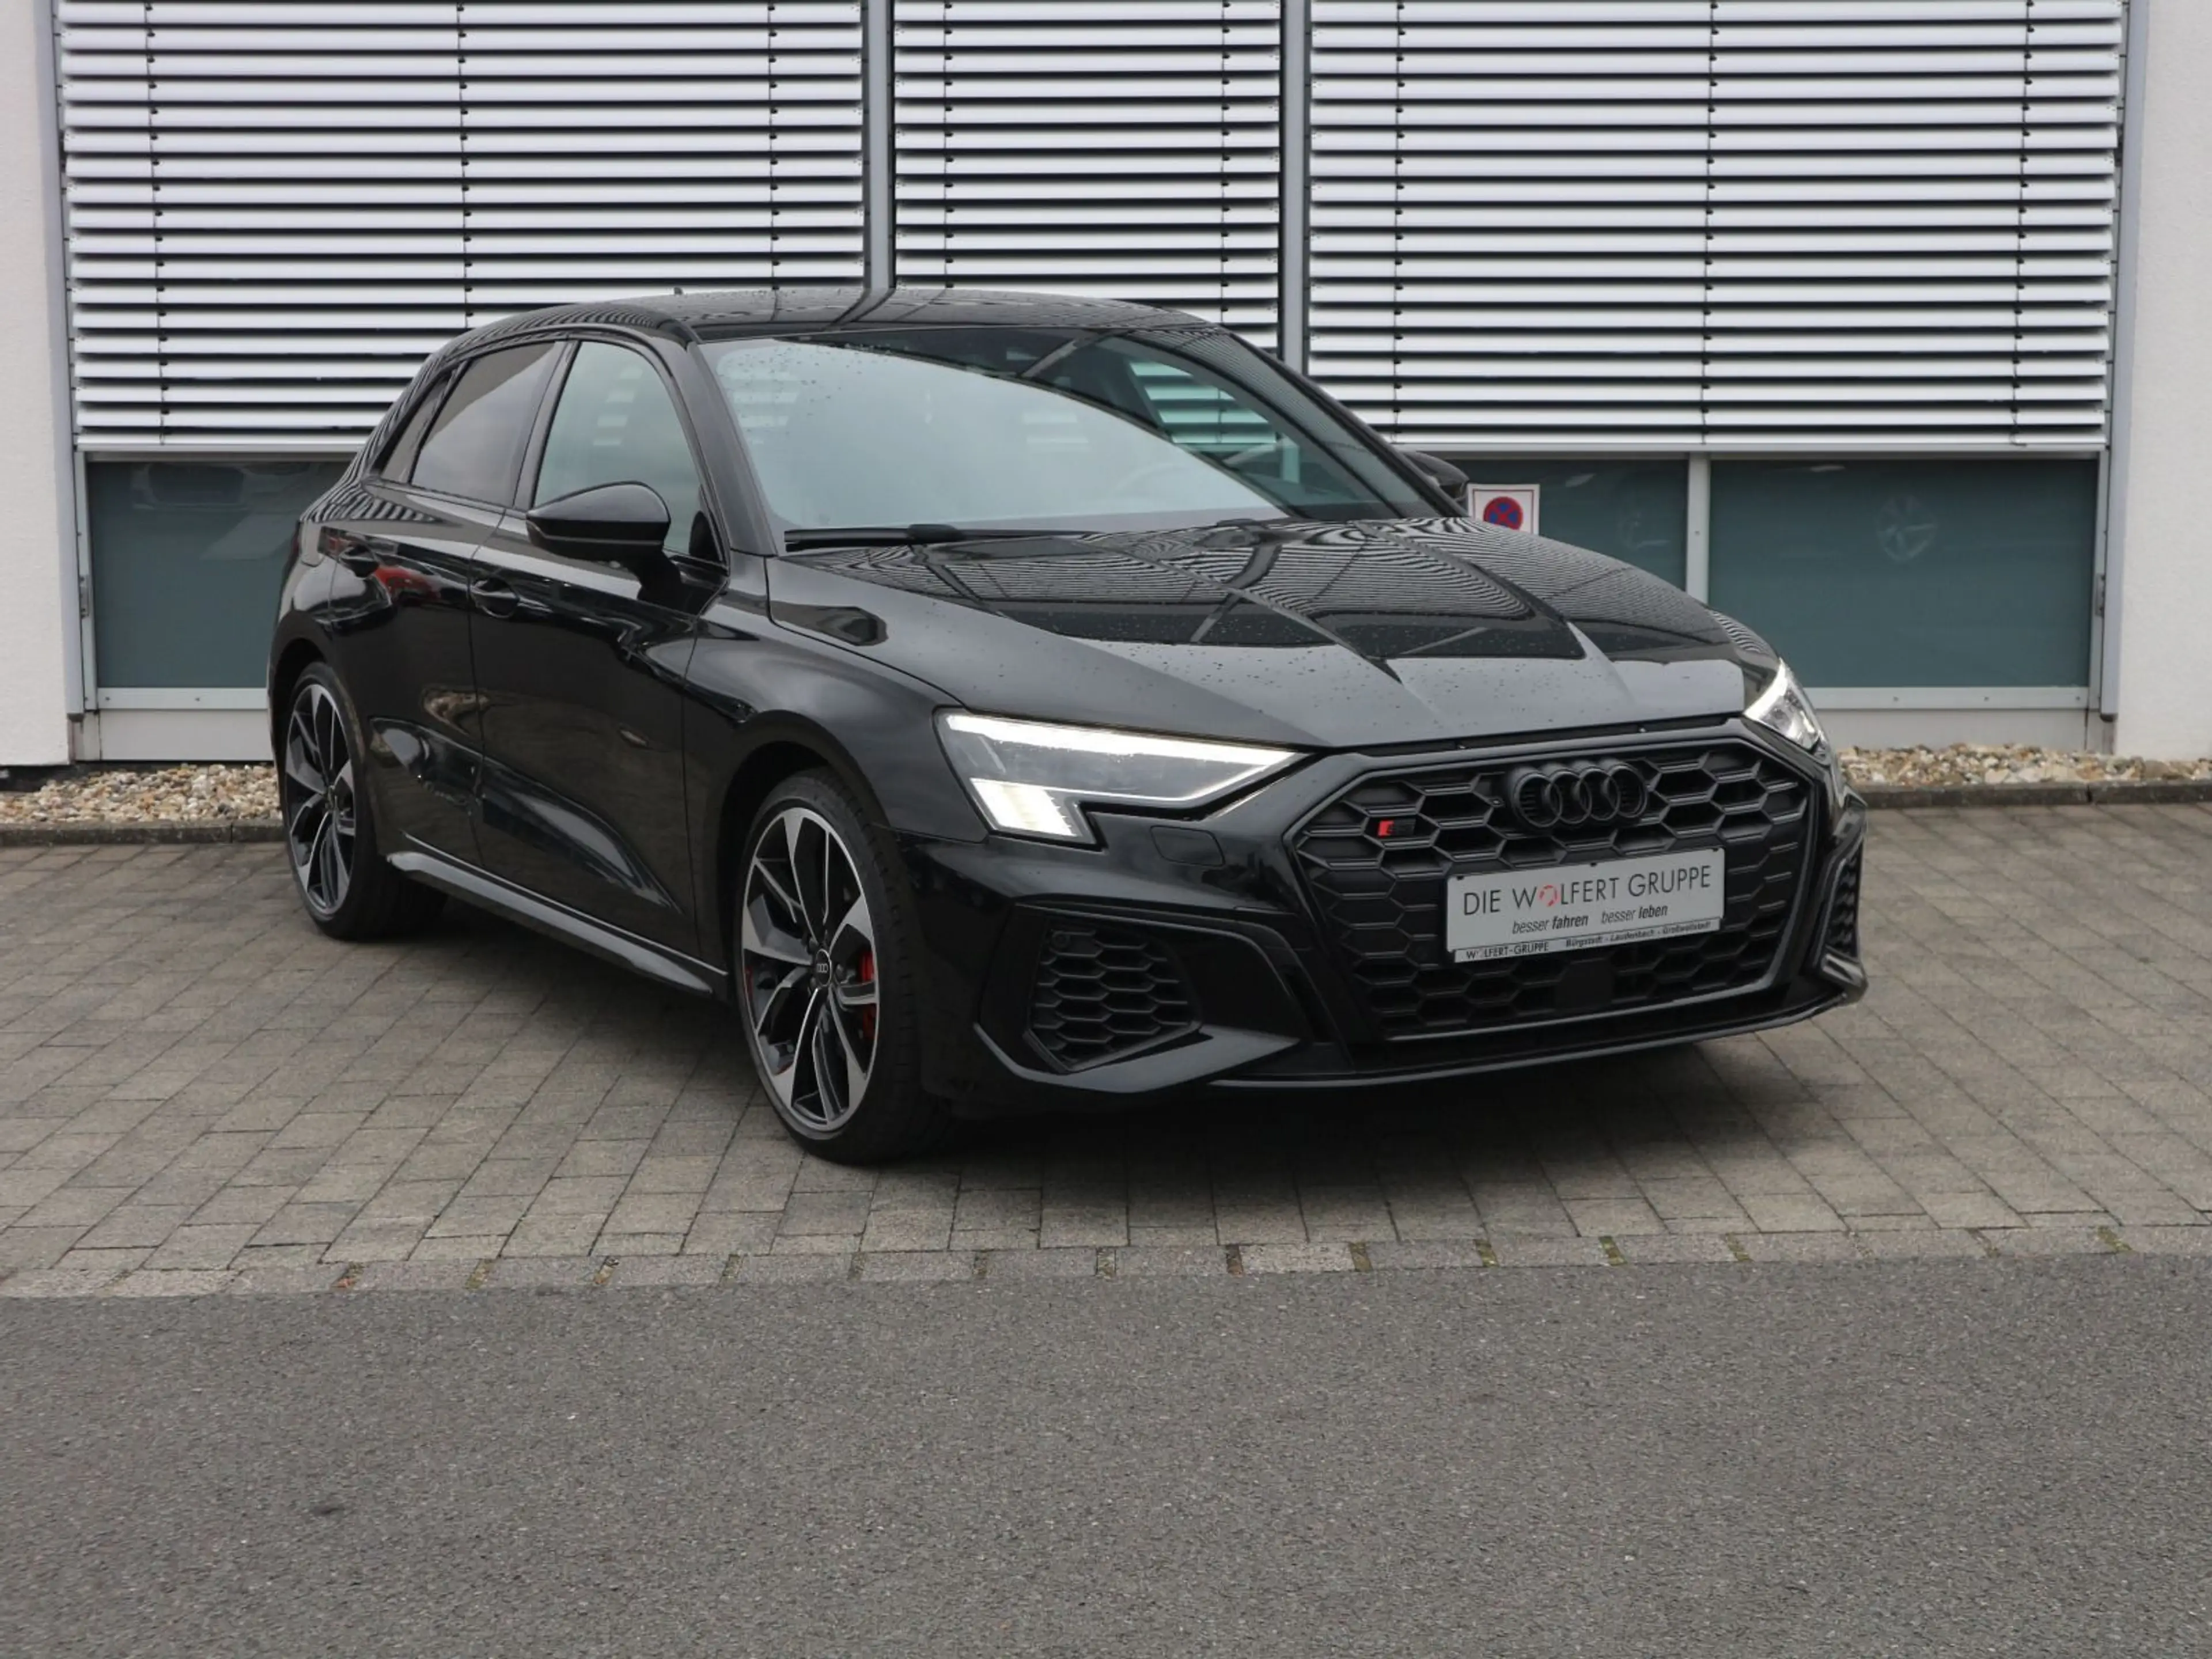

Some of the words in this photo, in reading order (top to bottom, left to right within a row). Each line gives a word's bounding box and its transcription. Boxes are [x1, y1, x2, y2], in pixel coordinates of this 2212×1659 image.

[1464, 889, 1502, 915] DIE
[1512, 877, 1619, 909] WOLFERT
[1628, 865, 1711, 896] GRUPPE
[1512, 920, 1550, 934] besser
[1552, 914, 1588, 929] fahren
[1601, 909, 1636, 924] besser
[1638, 904, 1668, 918] leben
[1466, 942, 1549, 959] WLFERT-GRUPPE
